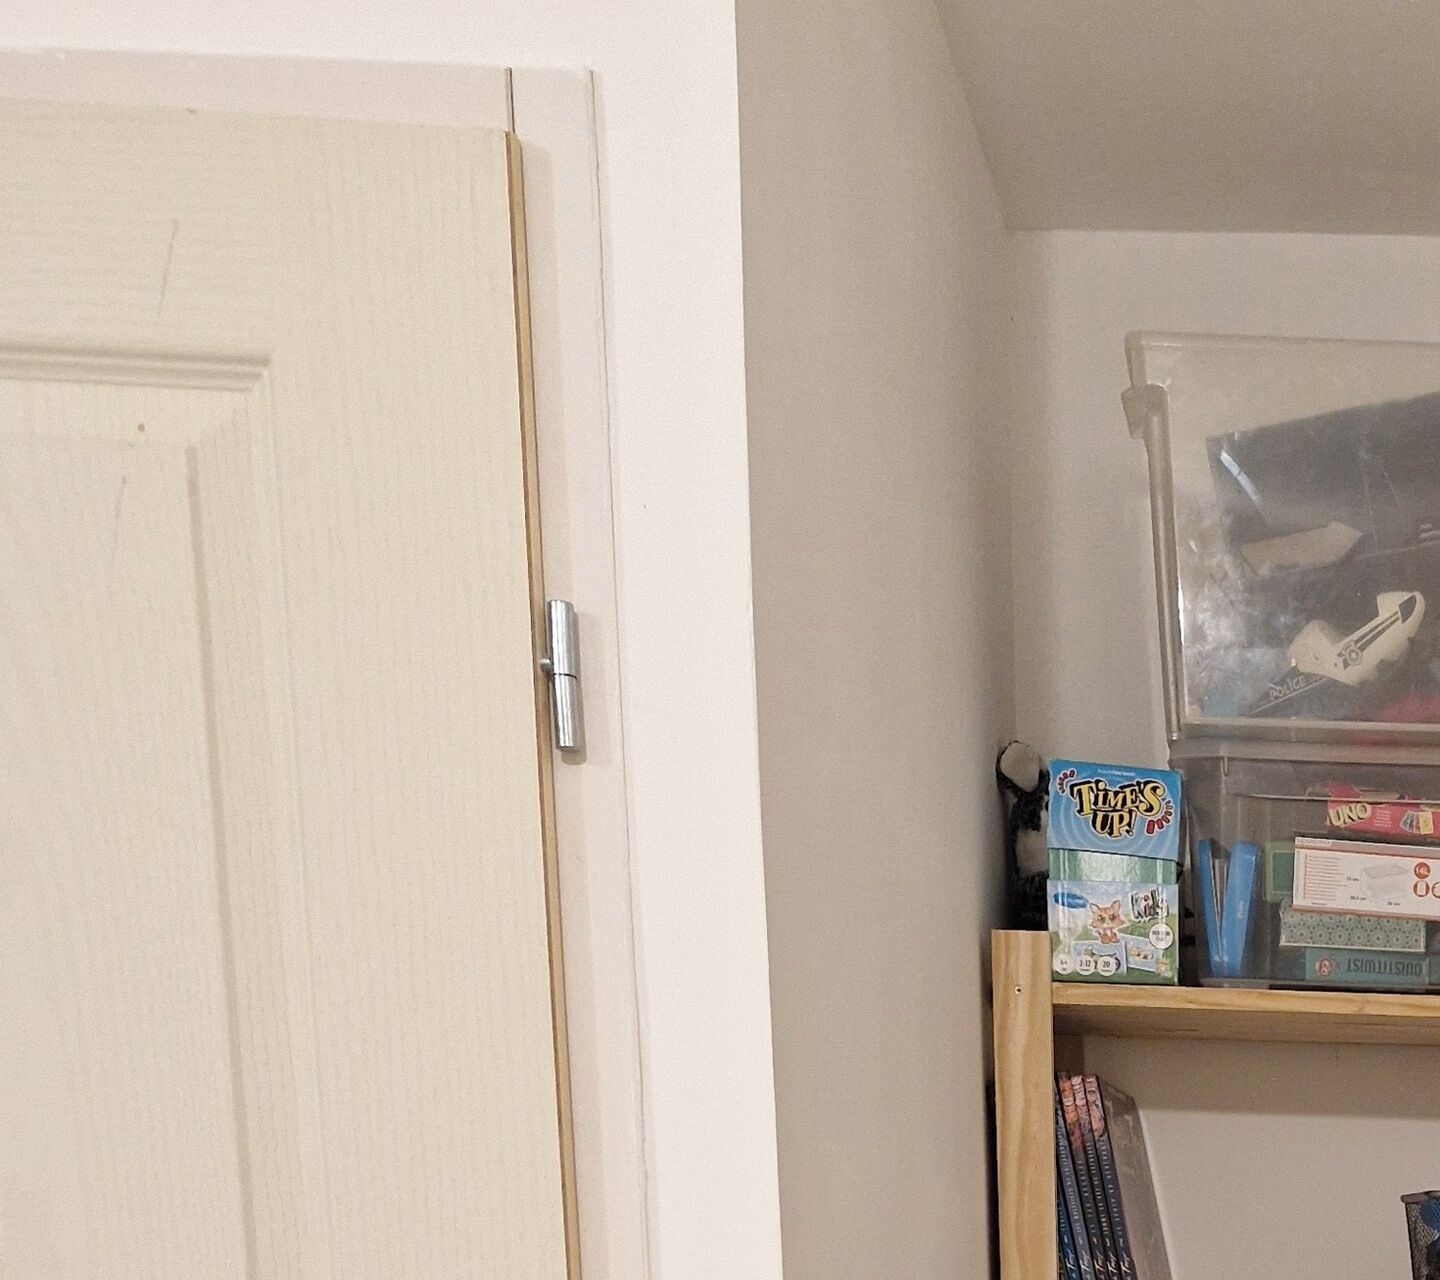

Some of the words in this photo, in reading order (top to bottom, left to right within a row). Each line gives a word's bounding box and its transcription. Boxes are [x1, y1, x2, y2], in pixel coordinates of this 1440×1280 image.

[1270, 675, 1305, 700] POLICE
[1092, 809, 1137, 837] UP!
[1328, 803, 1371, 828] UNO
